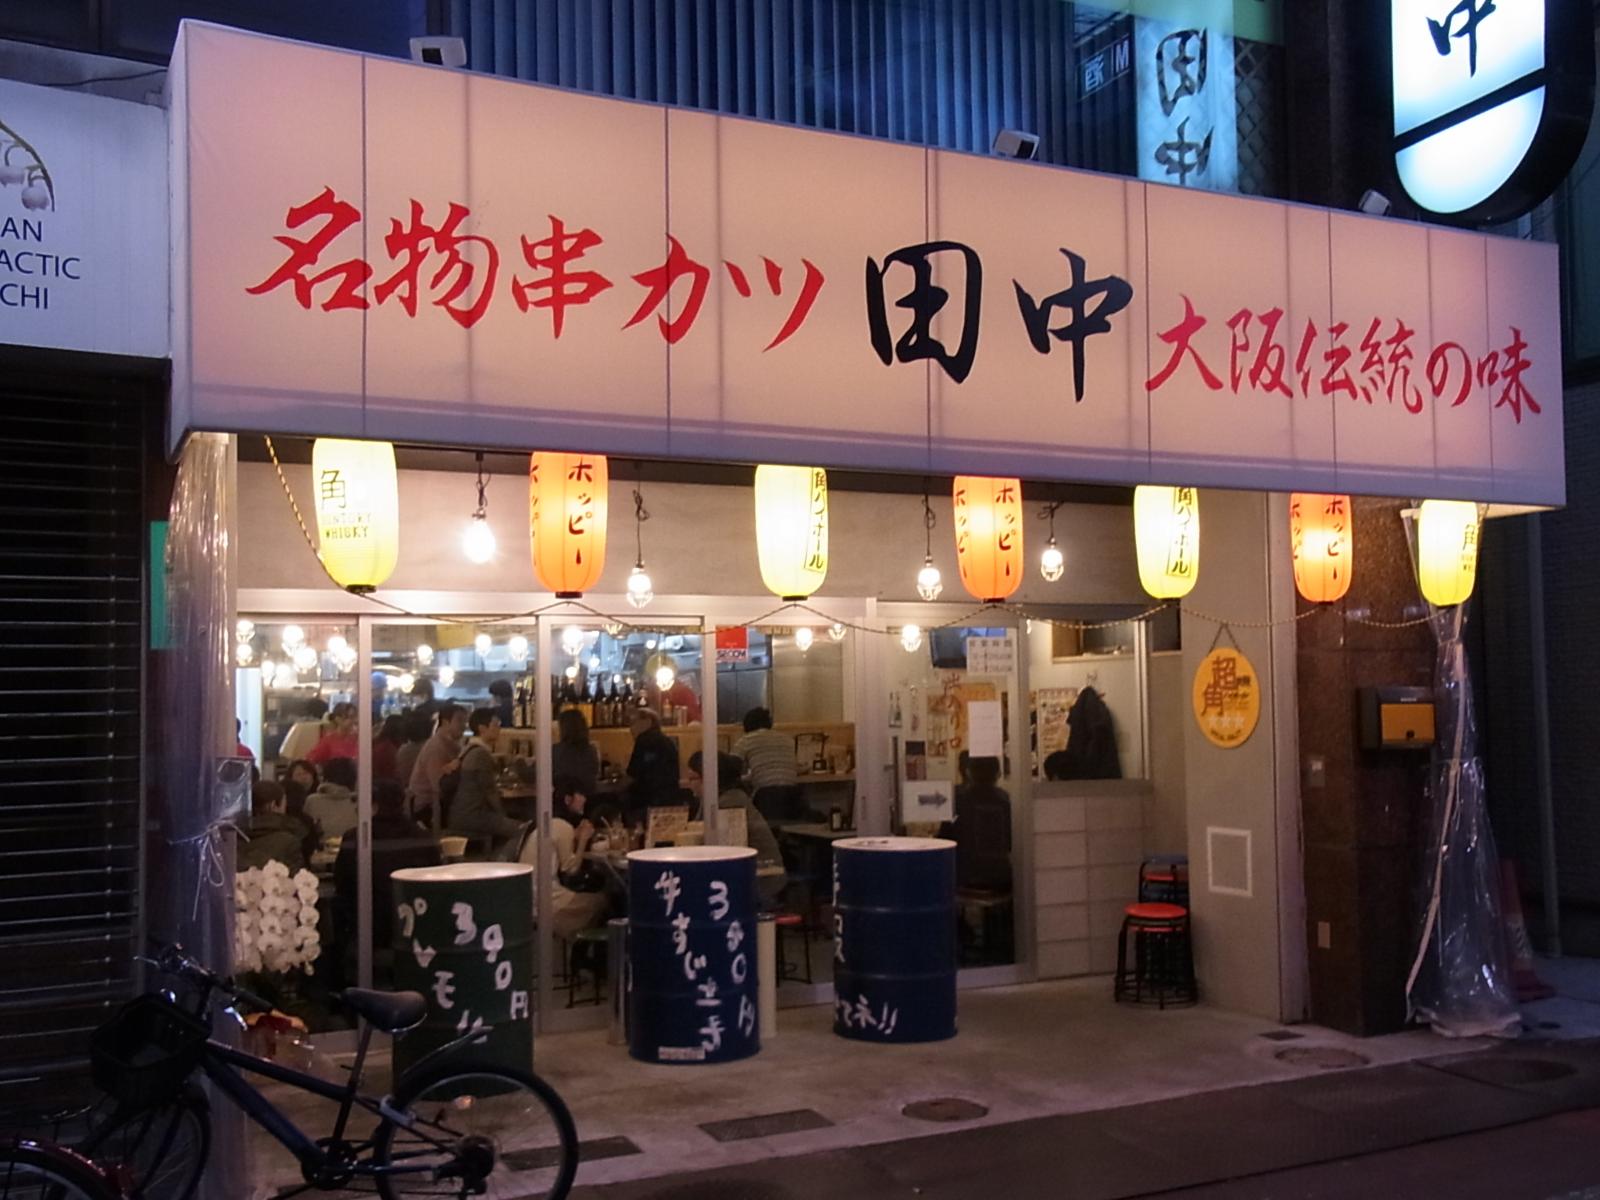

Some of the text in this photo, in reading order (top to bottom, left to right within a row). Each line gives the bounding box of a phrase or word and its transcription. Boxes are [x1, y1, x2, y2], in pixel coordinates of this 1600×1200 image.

[1425, 0, 1496, 78] 中
[245, 185, 1541, 425] 名物串カツ 田中 大阪伝統の味
[321, 470, 347, 509] 角
[568, 457, 593, 565] ホッピー
[996, 482, 1016, 577] ホッピー
[1325, 495, 1344, 580] ホッピー
